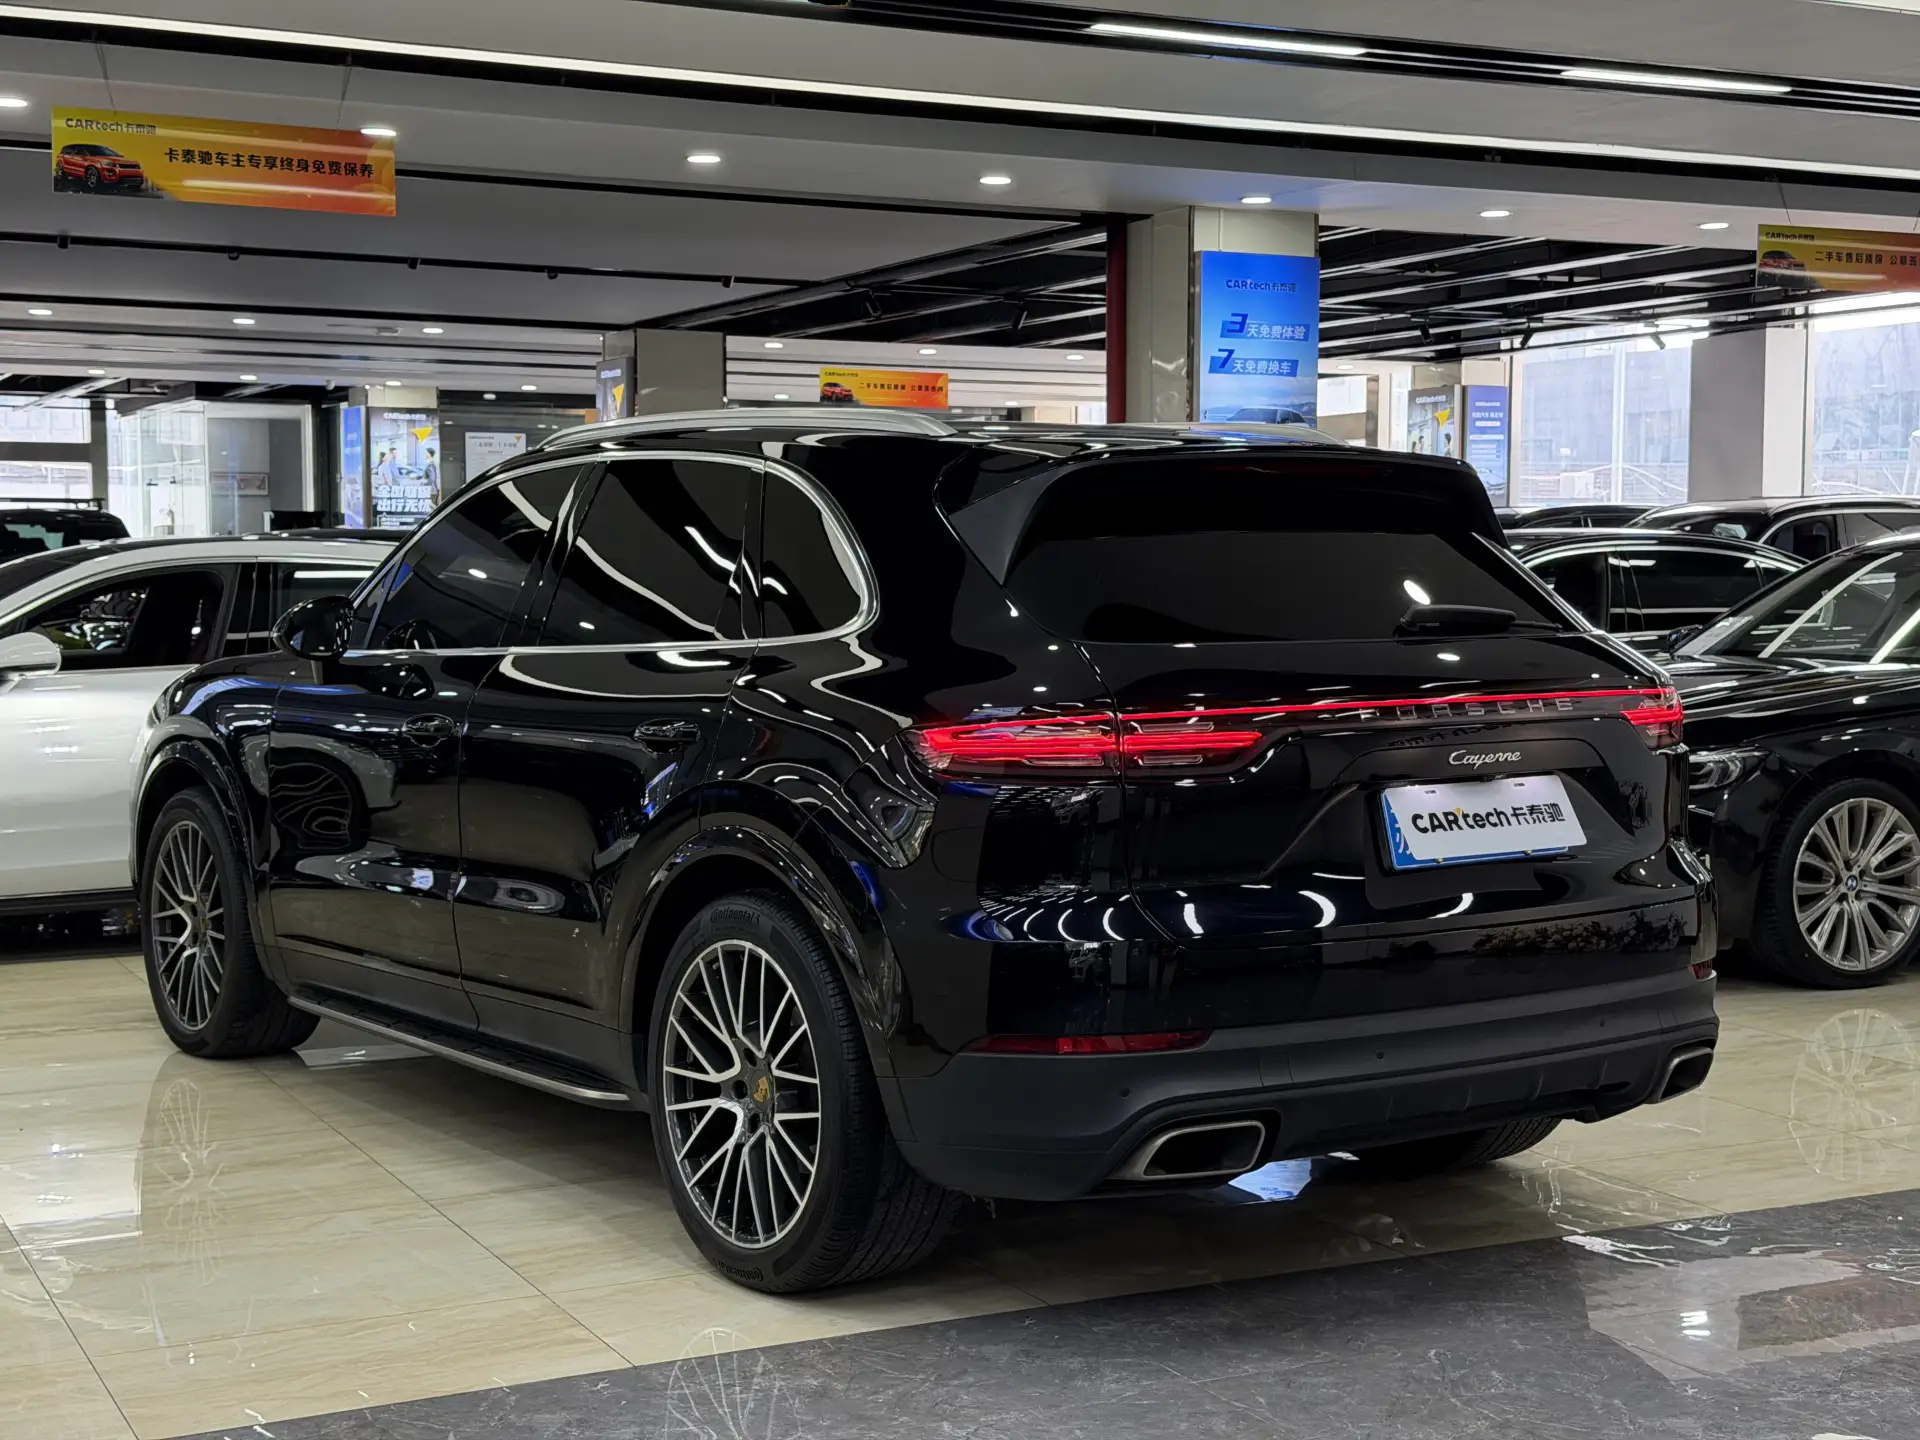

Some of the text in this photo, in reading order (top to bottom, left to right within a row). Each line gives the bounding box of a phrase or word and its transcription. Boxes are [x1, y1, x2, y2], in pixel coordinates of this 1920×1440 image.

[164, 147, 375, 178] 卡泰驰车主专享终身免费保养
[1226, 312, 1307, 340] 3天免费体验
[1217, 348, 1292, 375] 7天免费换车
[1448, 749, 1522, 770] Cayenne
[1411, 802, 1567, 834] CARtech卡泰驰
[710, 906, 755, 925] Continental
